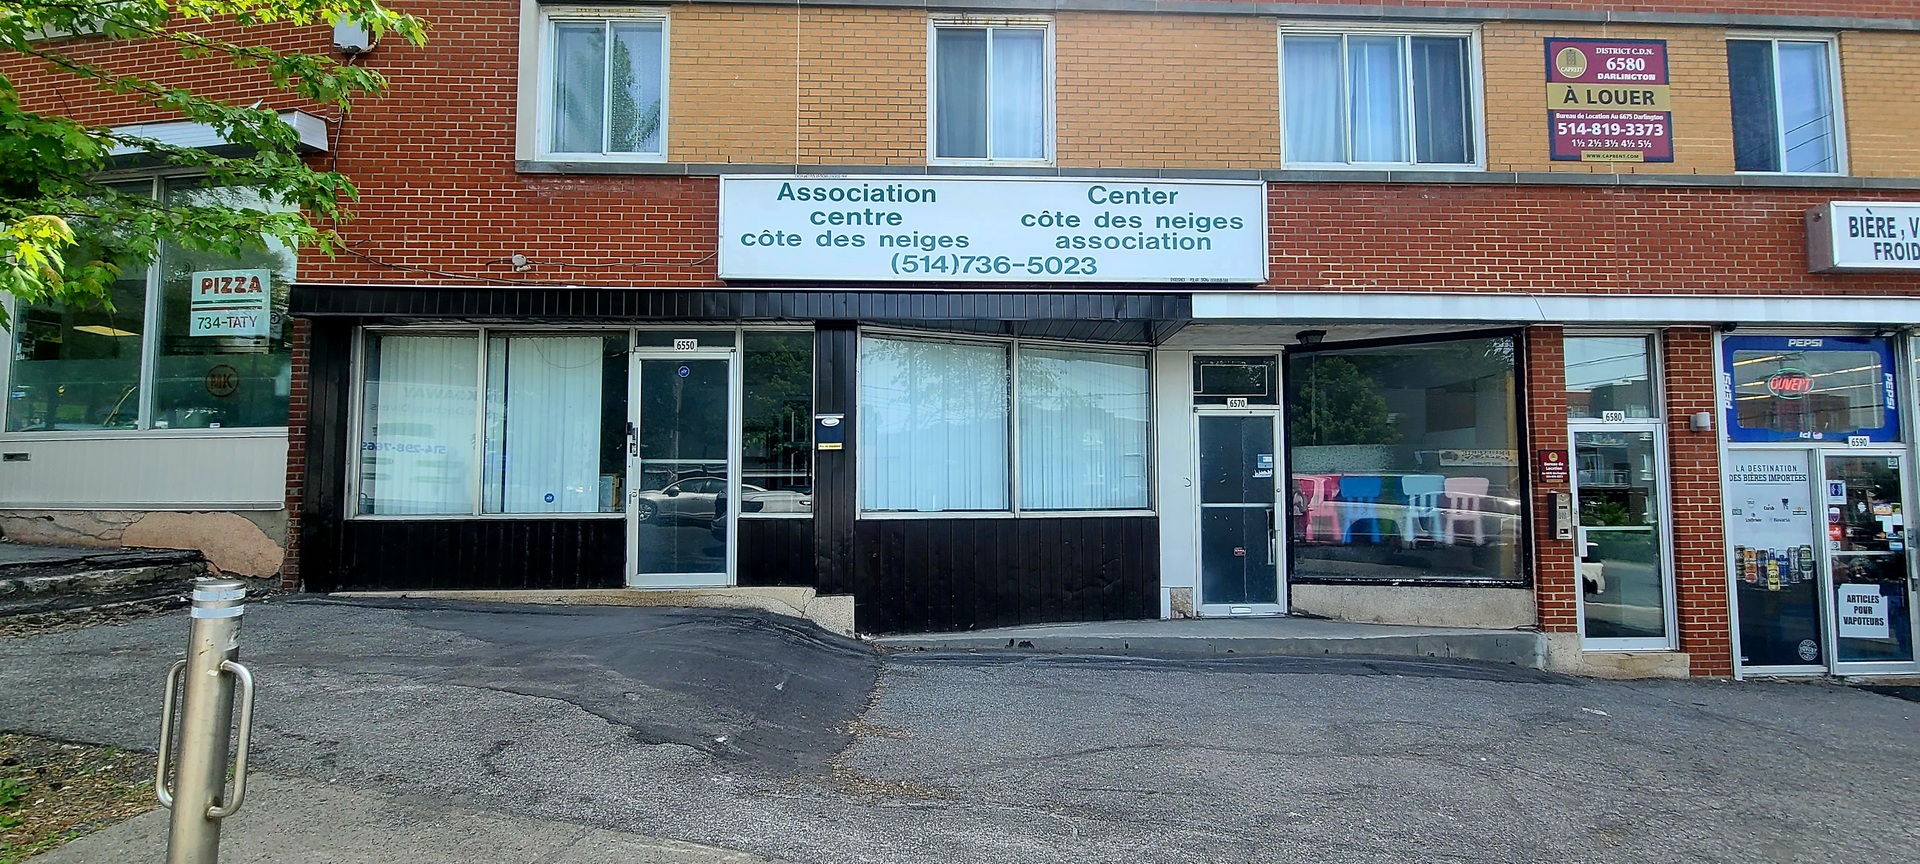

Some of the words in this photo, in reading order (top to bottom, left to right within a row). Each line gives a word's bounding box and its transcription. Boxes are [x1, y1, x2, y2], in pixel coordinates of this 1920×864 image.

[1595, 47, 1630, 55] DISTRICT
[1606, 57, 1645, 71] 6580
[1597, 73, 1656, 81] DARLINGTON
[1563, 85, 1579, 104] À
[1586, 89, 1655, 105] LOUER
[1558, 122, 1664, 136] 514-819-3373
[1571, 139, 1585, 147] 1½
[1587, 139, 1602, 147] 2½
[1604, 139, 1619, 148] 3½
[1620, 139, 1635, 148] 4½
[1637, 140, 1652, 148] 5½
[777, 182, 937, 203] Association
[1088, 185, 1179, 205] Center
[810, 208, 903, 226] centre
[1021, 210, 1081, 228] côte
[1094, 211, 1143, 229] des
[1156, 212, 1244, 233] neiges
[740, 229, 802, 247] côte
[815, 230, 866, 247] des
[879, 231, 970, 252] neiges
[1055, 232, 1212, 250] association
[891, 252, 1098, 276] (514)736-5023
[201, 276, 263, 294] PIZZA
[197, 315, 258, 330] 734-TATY
[676, 340, 695, 350] 6550
[1788, 339, 1823, 347] PEPSI
[1723, 373, 1733, 409] PEPSI
[1884, 372, 1895, 410] PEPSI
[1229, 400, 1246, 409] 6570
[1605, 412, 1623, 422] 6580
[1851, 437, 1868, 447] 6590
[1748, 464, 1797, 472] DESTINATION
[1846, 595, 1879, 604] ARTICLES
[1853, 606, 1873, 614] POUR
[1843, 617, 1884, 626] VAPOTEURS
